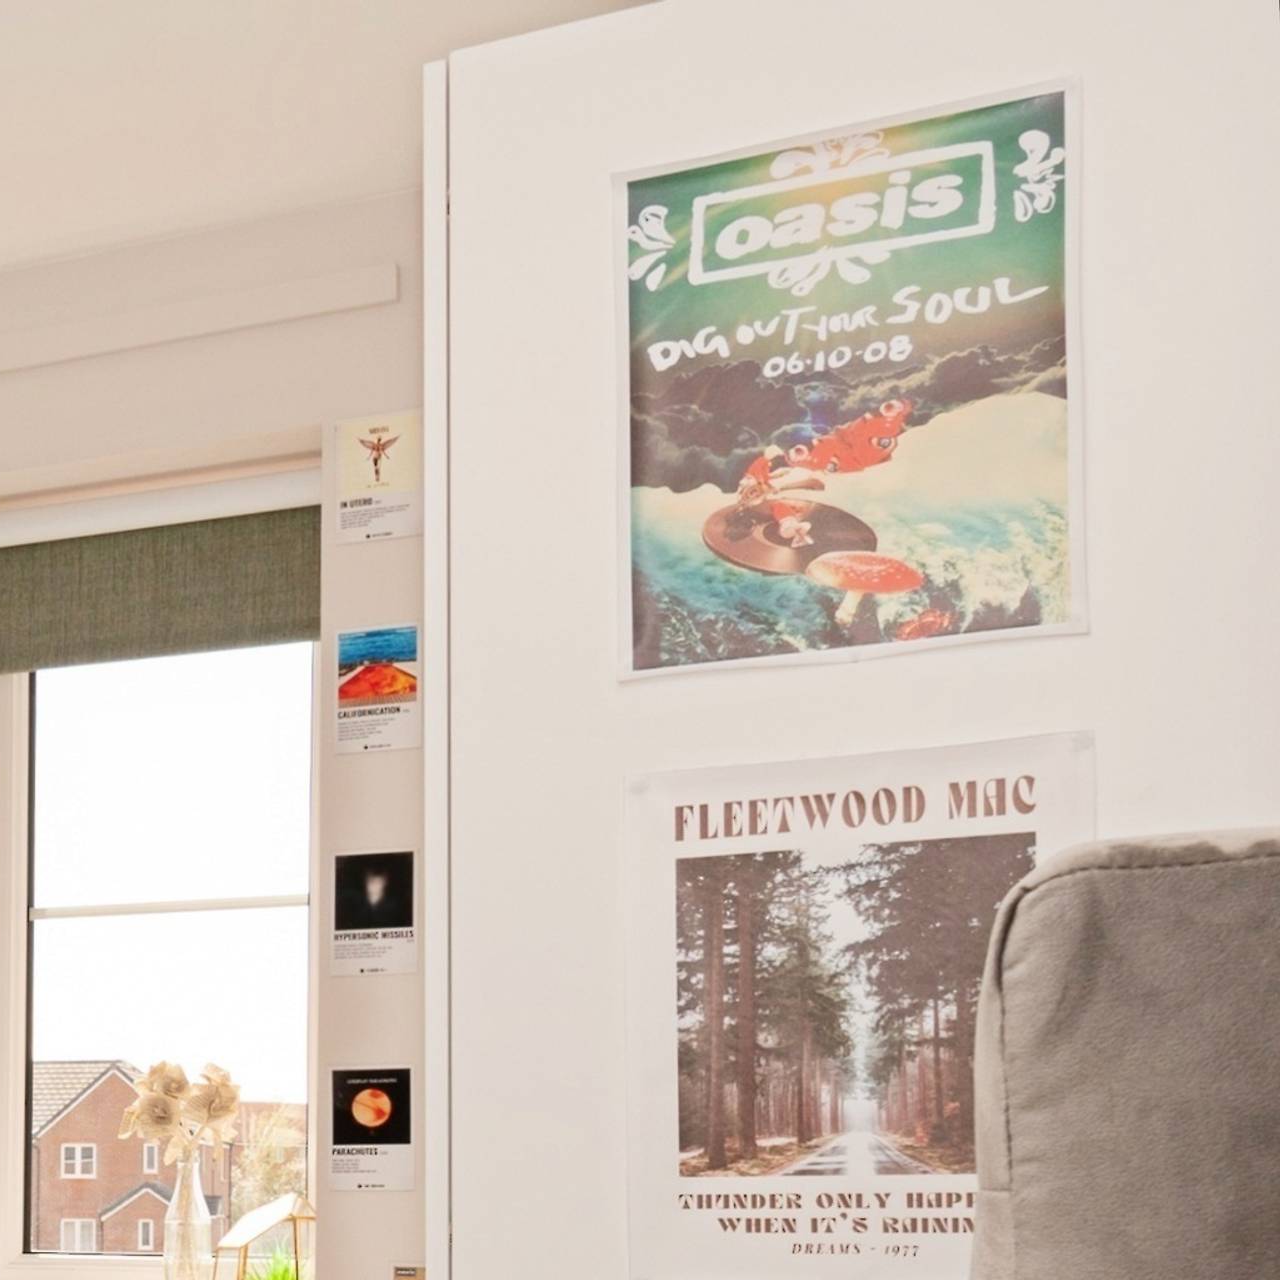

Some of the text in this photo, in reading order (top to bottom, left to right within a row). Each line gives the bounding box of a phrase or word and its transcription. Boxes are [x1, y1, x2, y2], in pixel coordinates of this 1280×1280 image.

[715, 169, 964, 260] oasis
[647, 326, 731, 373] DIG
[886, 277, 1050, 326] SOUL
[337, 706, 401, 720] CALIFORNICATION
[675, 775, 1037, 842] FLEETWOOD MAC
[334, 930, 415, 941] HYPERSONIC MISSILES
[332, 1147, 378, 1156] PARACHUTES
[677, 1192, 803, 1209] THUNDER
[815, 1192, 891, 1209] ONLY
[717, 1217, 797, 1233] WHEN
[810, 1212, 868, 1233] IT'S
[791, 1243, 861, 1255] DREAMS
[884, 1244, 920, 1257] 1977
